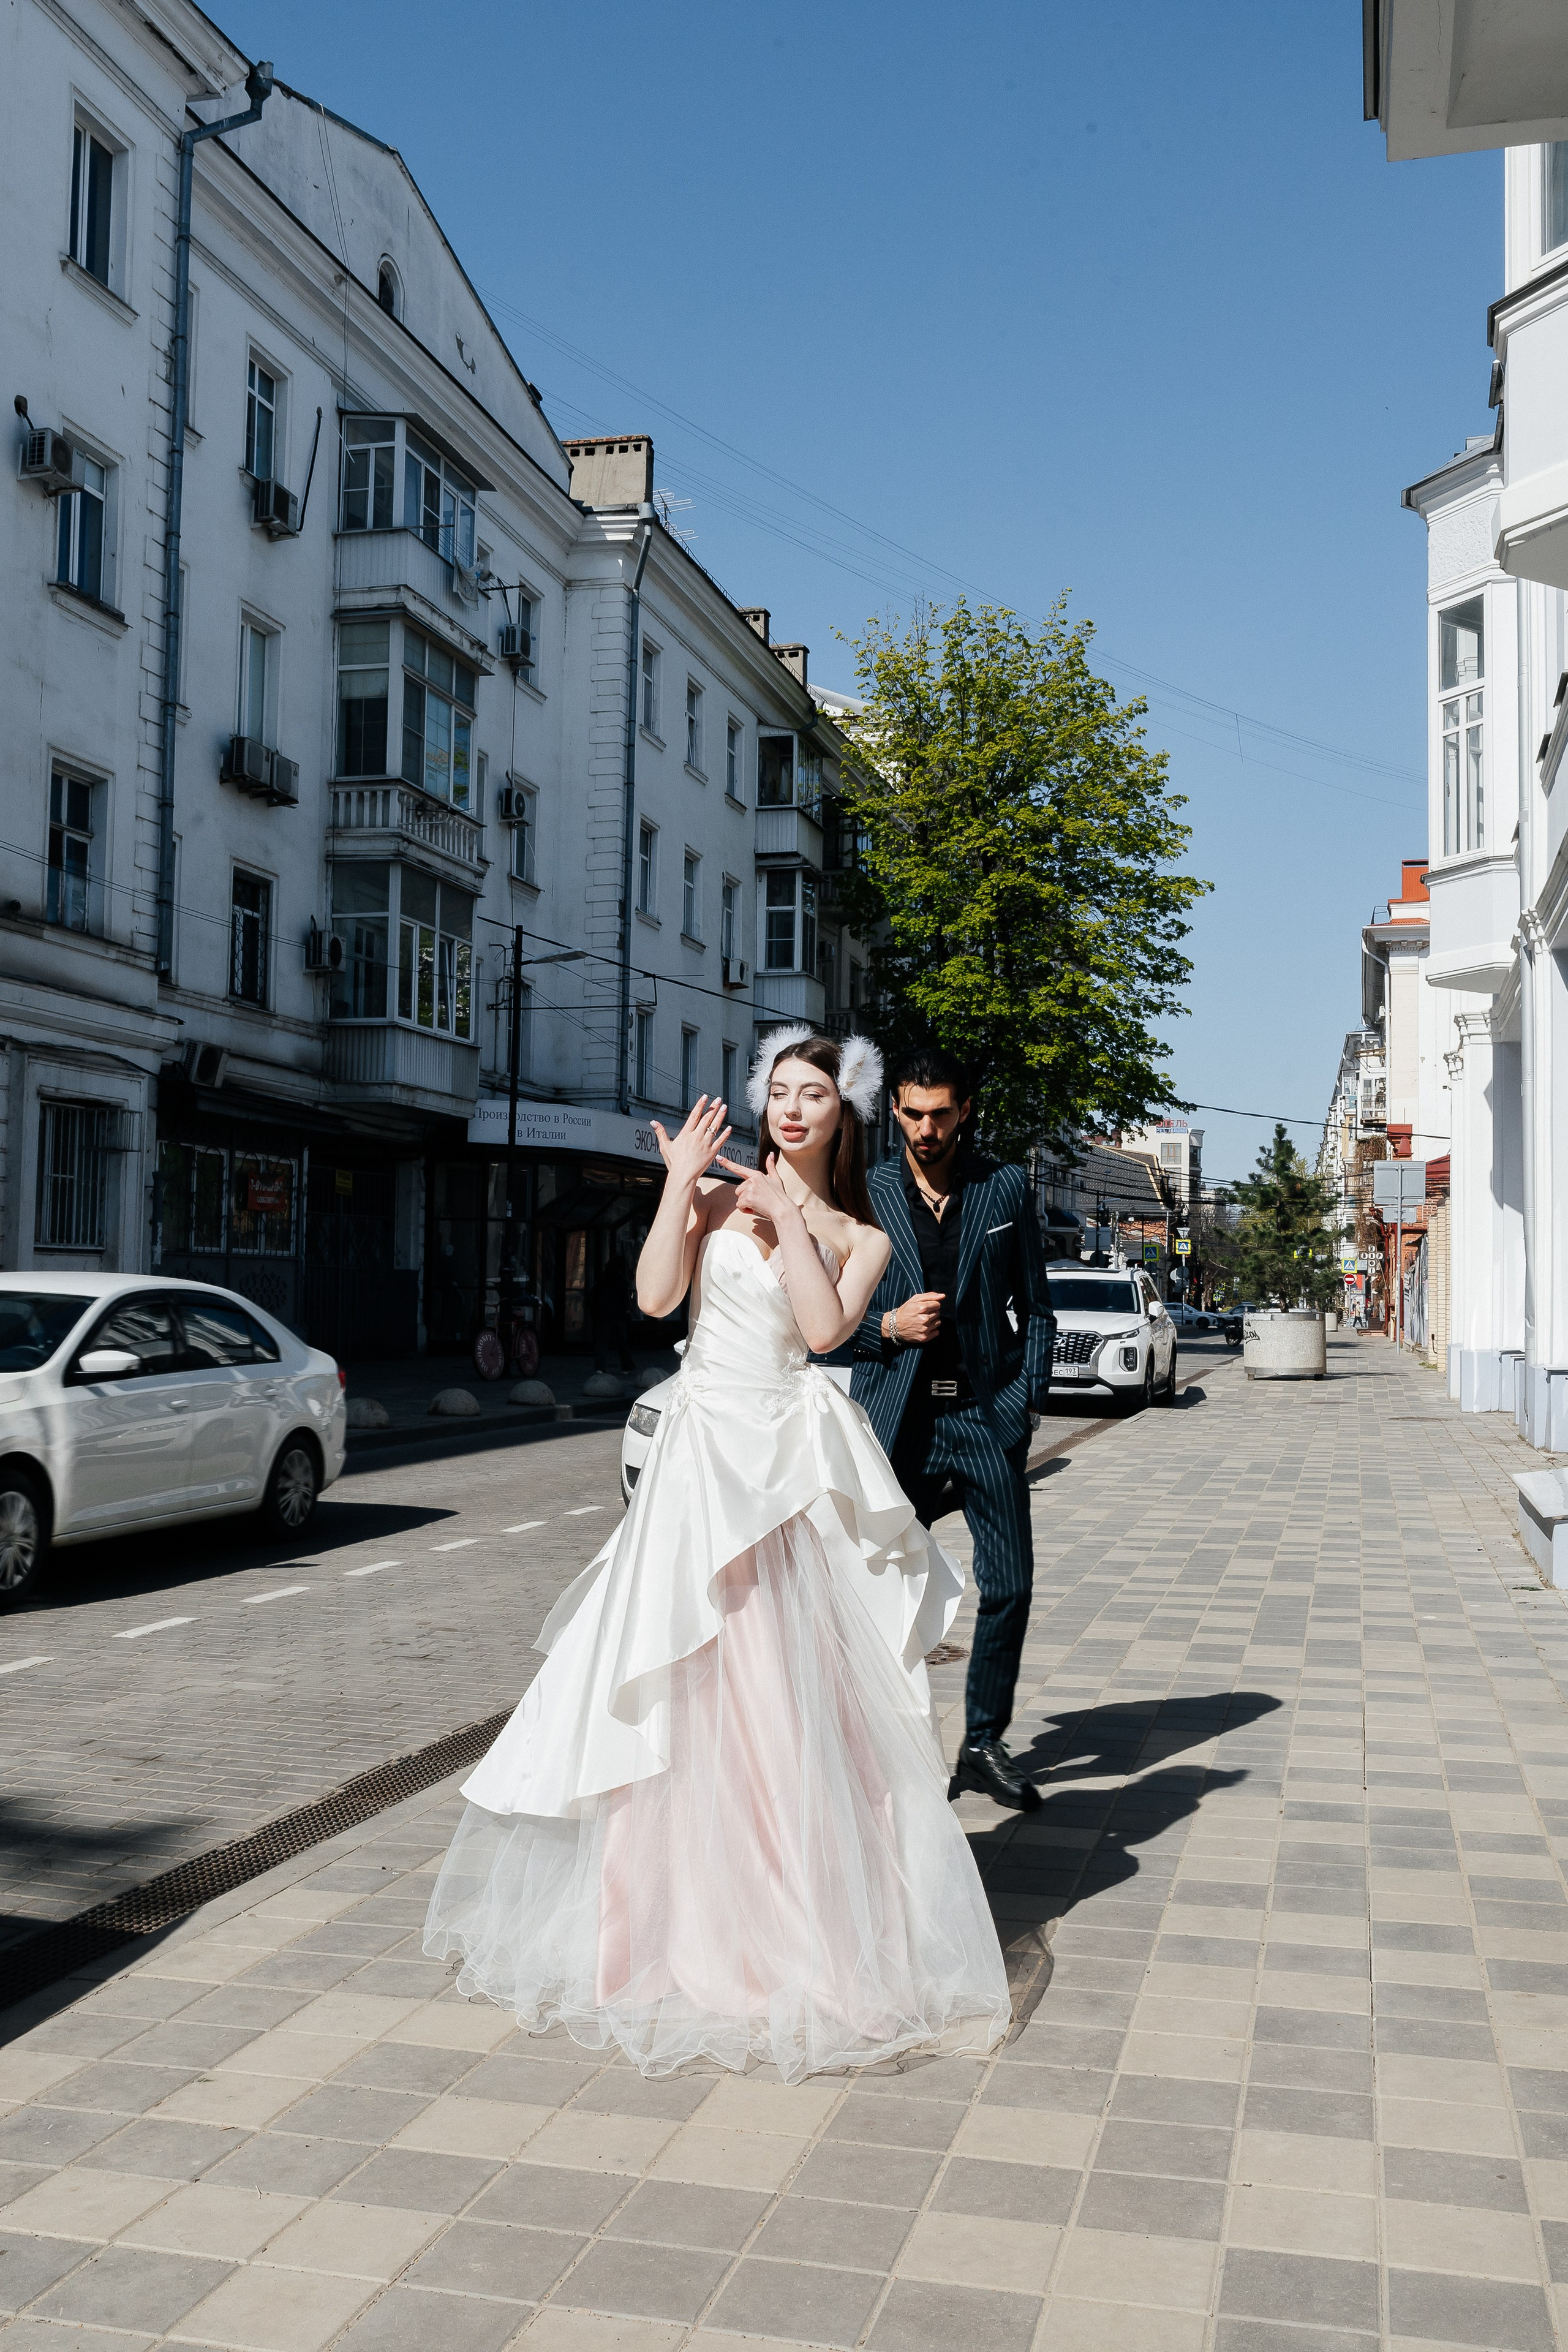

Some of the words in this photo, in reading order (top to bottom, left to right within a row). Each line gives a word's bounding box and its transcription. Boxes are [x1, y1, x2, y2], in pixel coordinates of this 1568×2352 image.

[473, 1107, 551, 1123] Произодство
[563, 1113, 592, 1126] России
[527, 1127, 567, 1140] Италии
